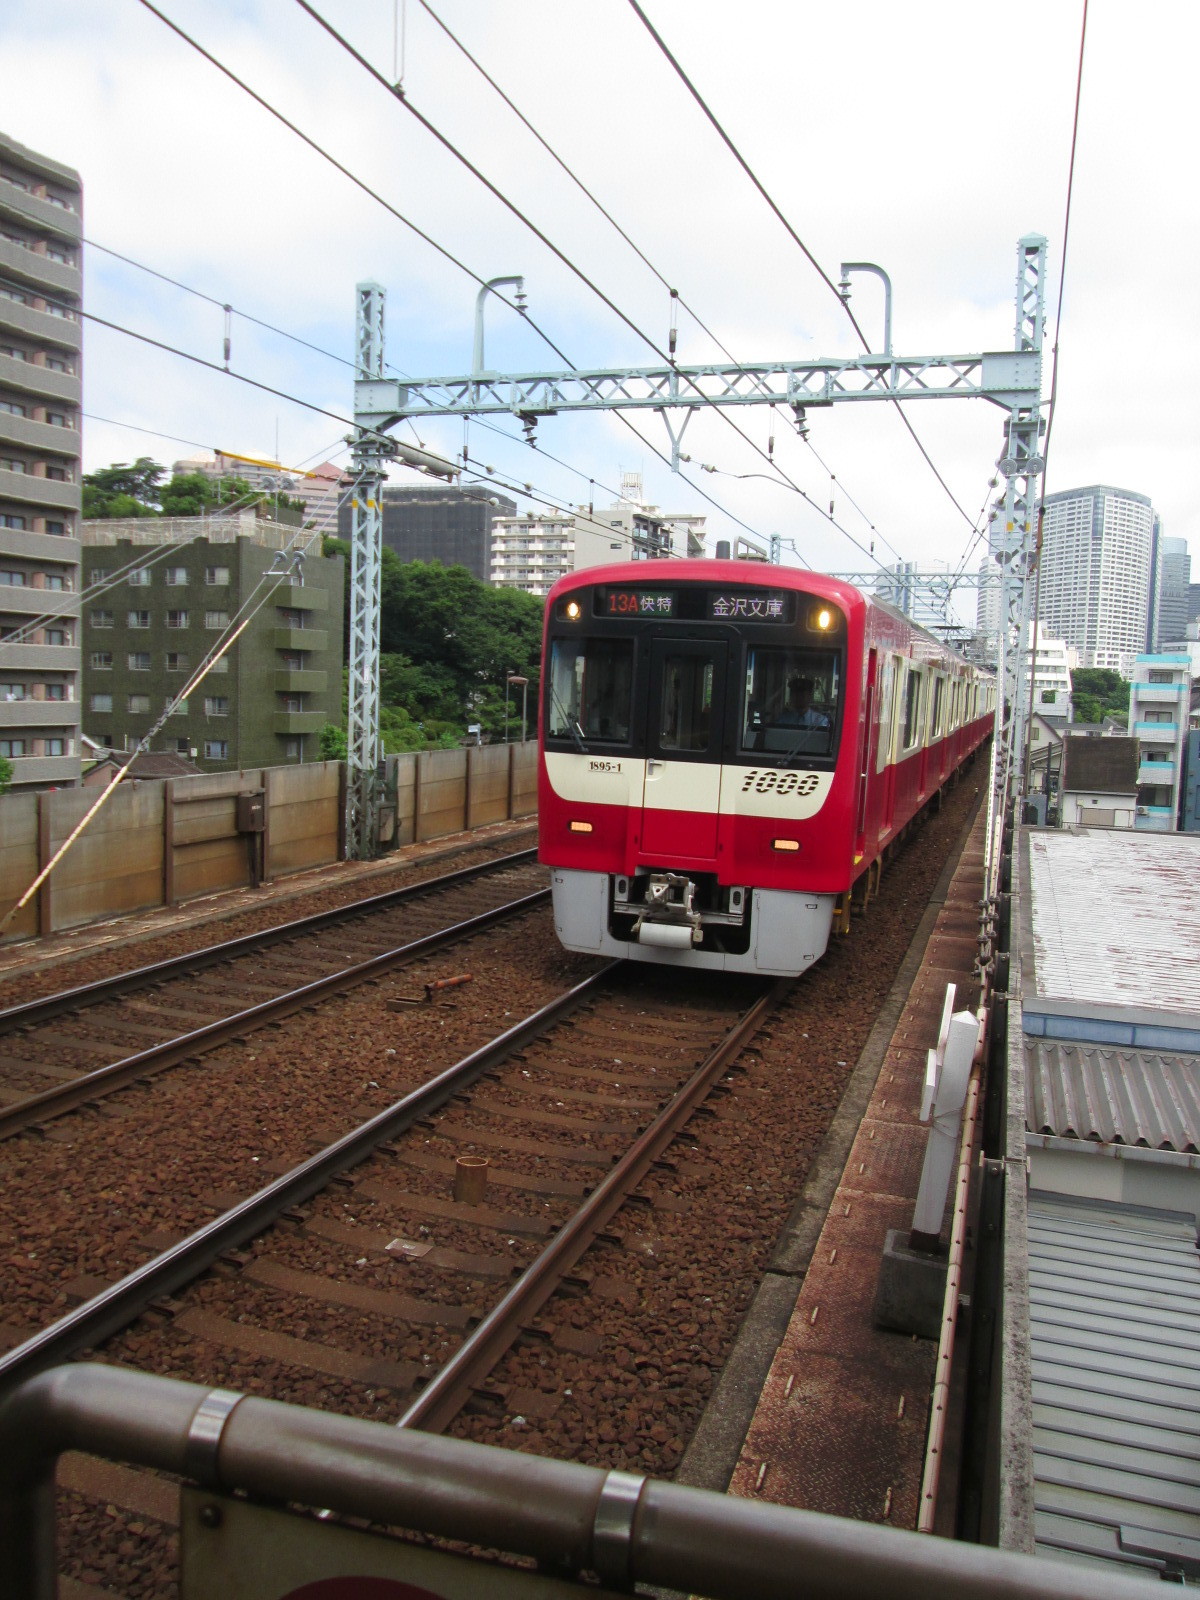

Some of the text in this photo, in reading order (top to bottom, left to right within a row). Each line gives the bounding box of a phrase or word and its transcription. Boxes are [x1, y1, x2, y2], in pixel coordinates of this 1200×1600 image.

[610, 594, 638, 612] 13A
[640, 595, 672, 612] 快特
[713, 597, 783, 617] 金沢文庫
[589, 761, 622, 772] 1895-1
[742, 771, 819, 796] 1000
